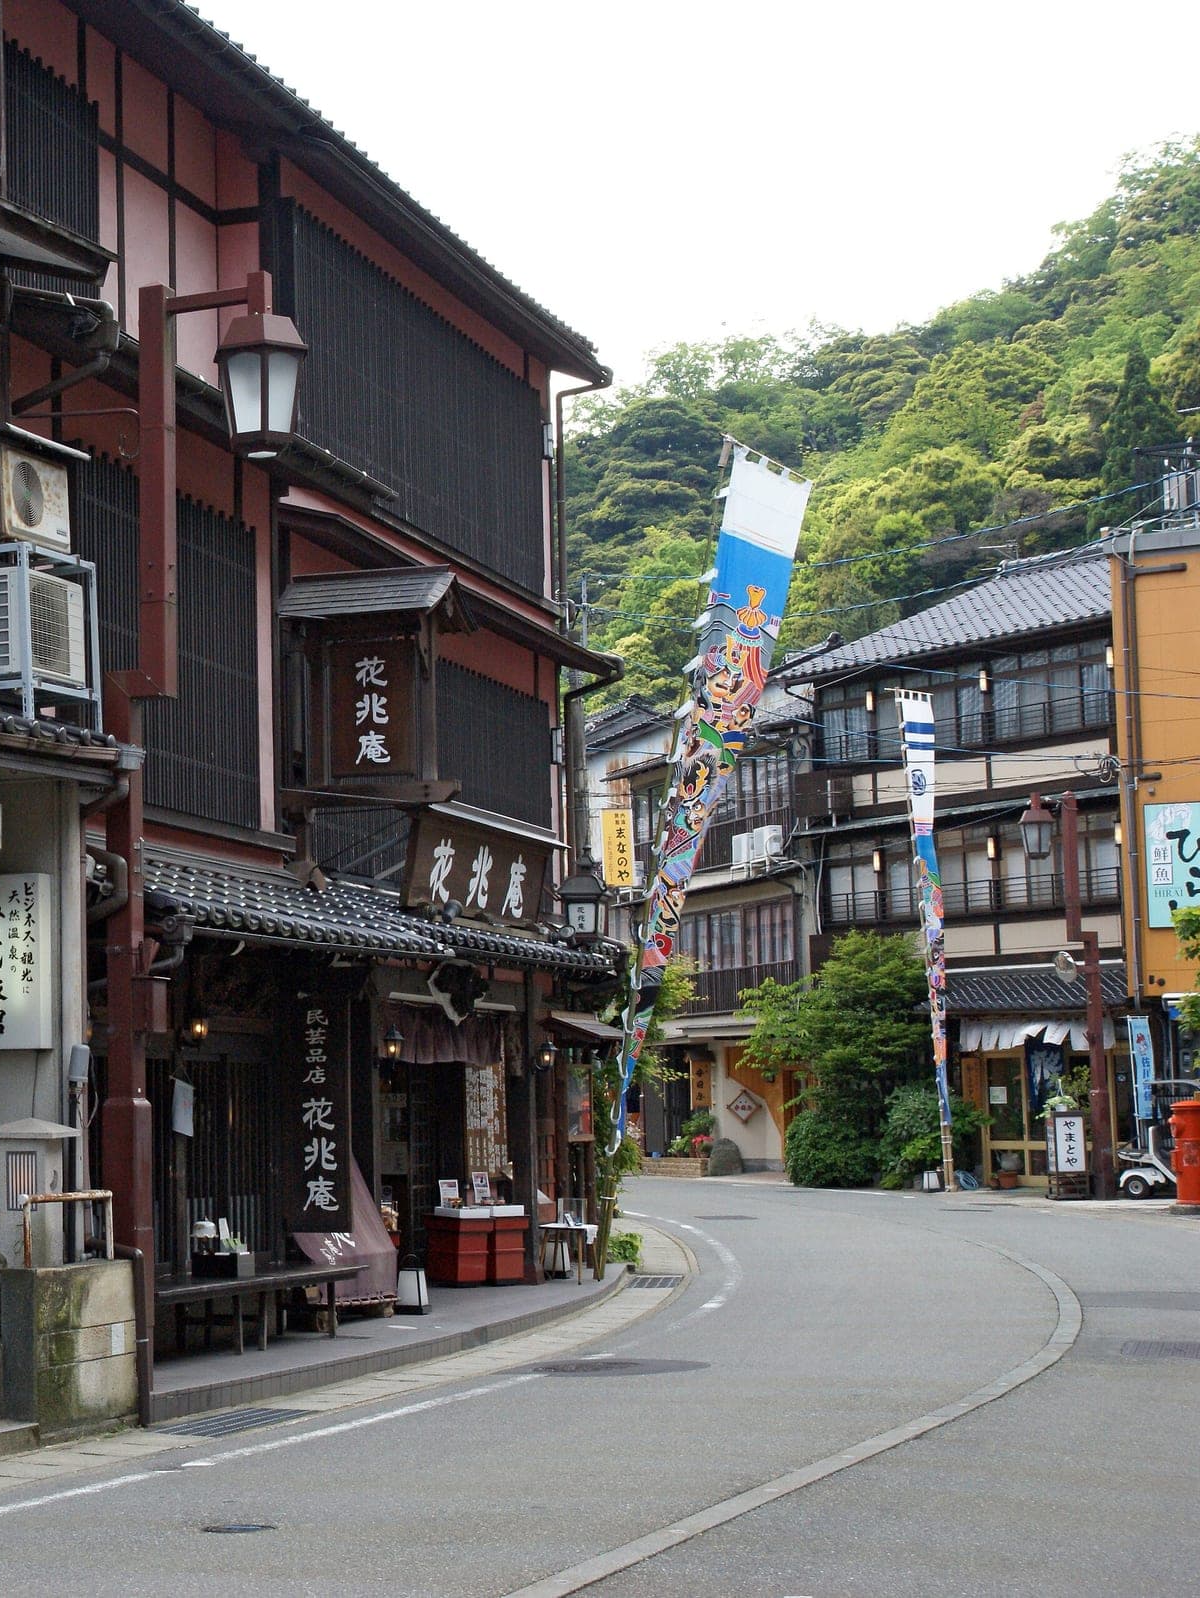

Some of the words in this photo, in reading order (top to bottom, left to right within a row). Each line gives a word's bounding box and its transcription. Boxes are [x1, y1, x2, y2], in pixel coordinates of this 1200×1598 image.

[355, 656, 391, 765] 花兆庵
[429, 838, 527, 919] 花兆庵
[1154, 847, 1169, 881] 鮮魚
[1154, 888, 1183, 898] HIRAI
[8, 890, 20, 973] 天然温泉の
[21, 882, 36, 994] ビジネス・観光に
[303, 1009, 328, 1084] 民芸品店
[302, 1097, 339, 1212] 花兆庵
[1064, 1121, 1078, 1166] やまとや
